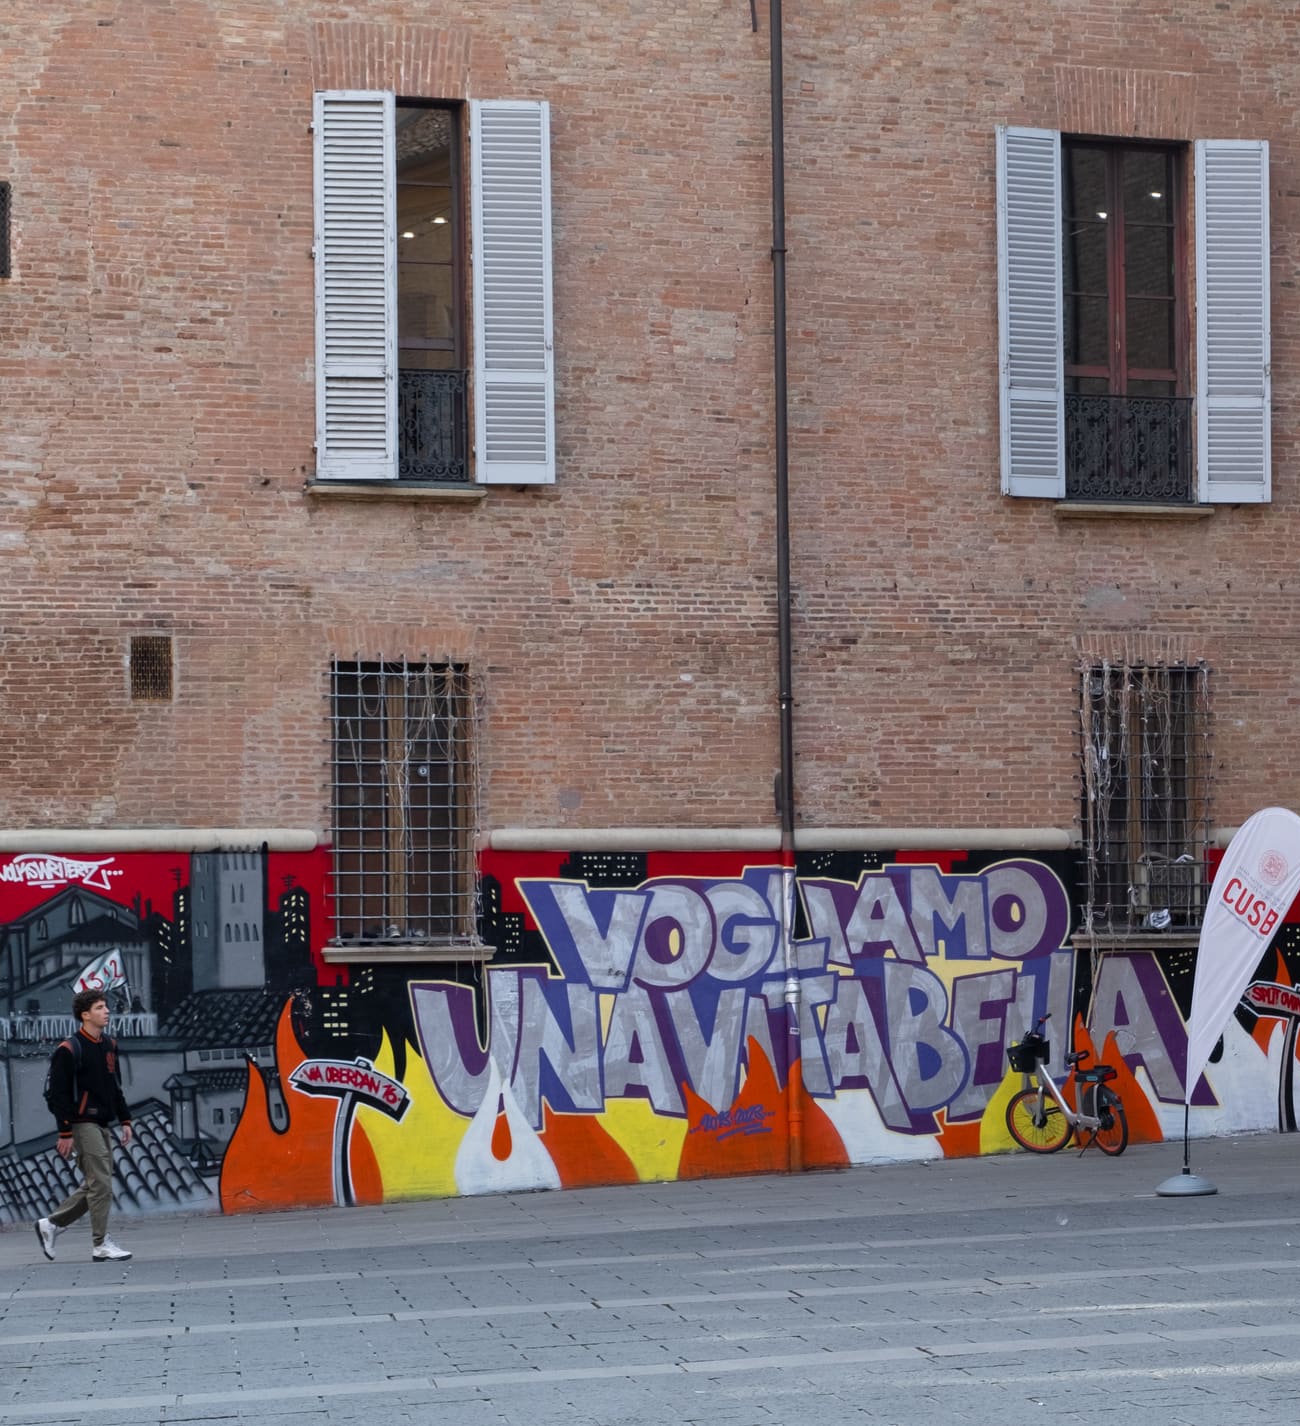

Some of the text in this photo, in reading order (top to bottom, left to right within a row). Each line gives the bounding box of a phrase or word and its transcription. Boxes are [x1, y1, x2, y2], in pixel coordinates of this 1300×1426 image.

[516, 860, 1069, 992] VOGLIAMO
[1223, 878, 1279, 936] CUSB
[326, 1066, 380, 1094] OBERDAN
